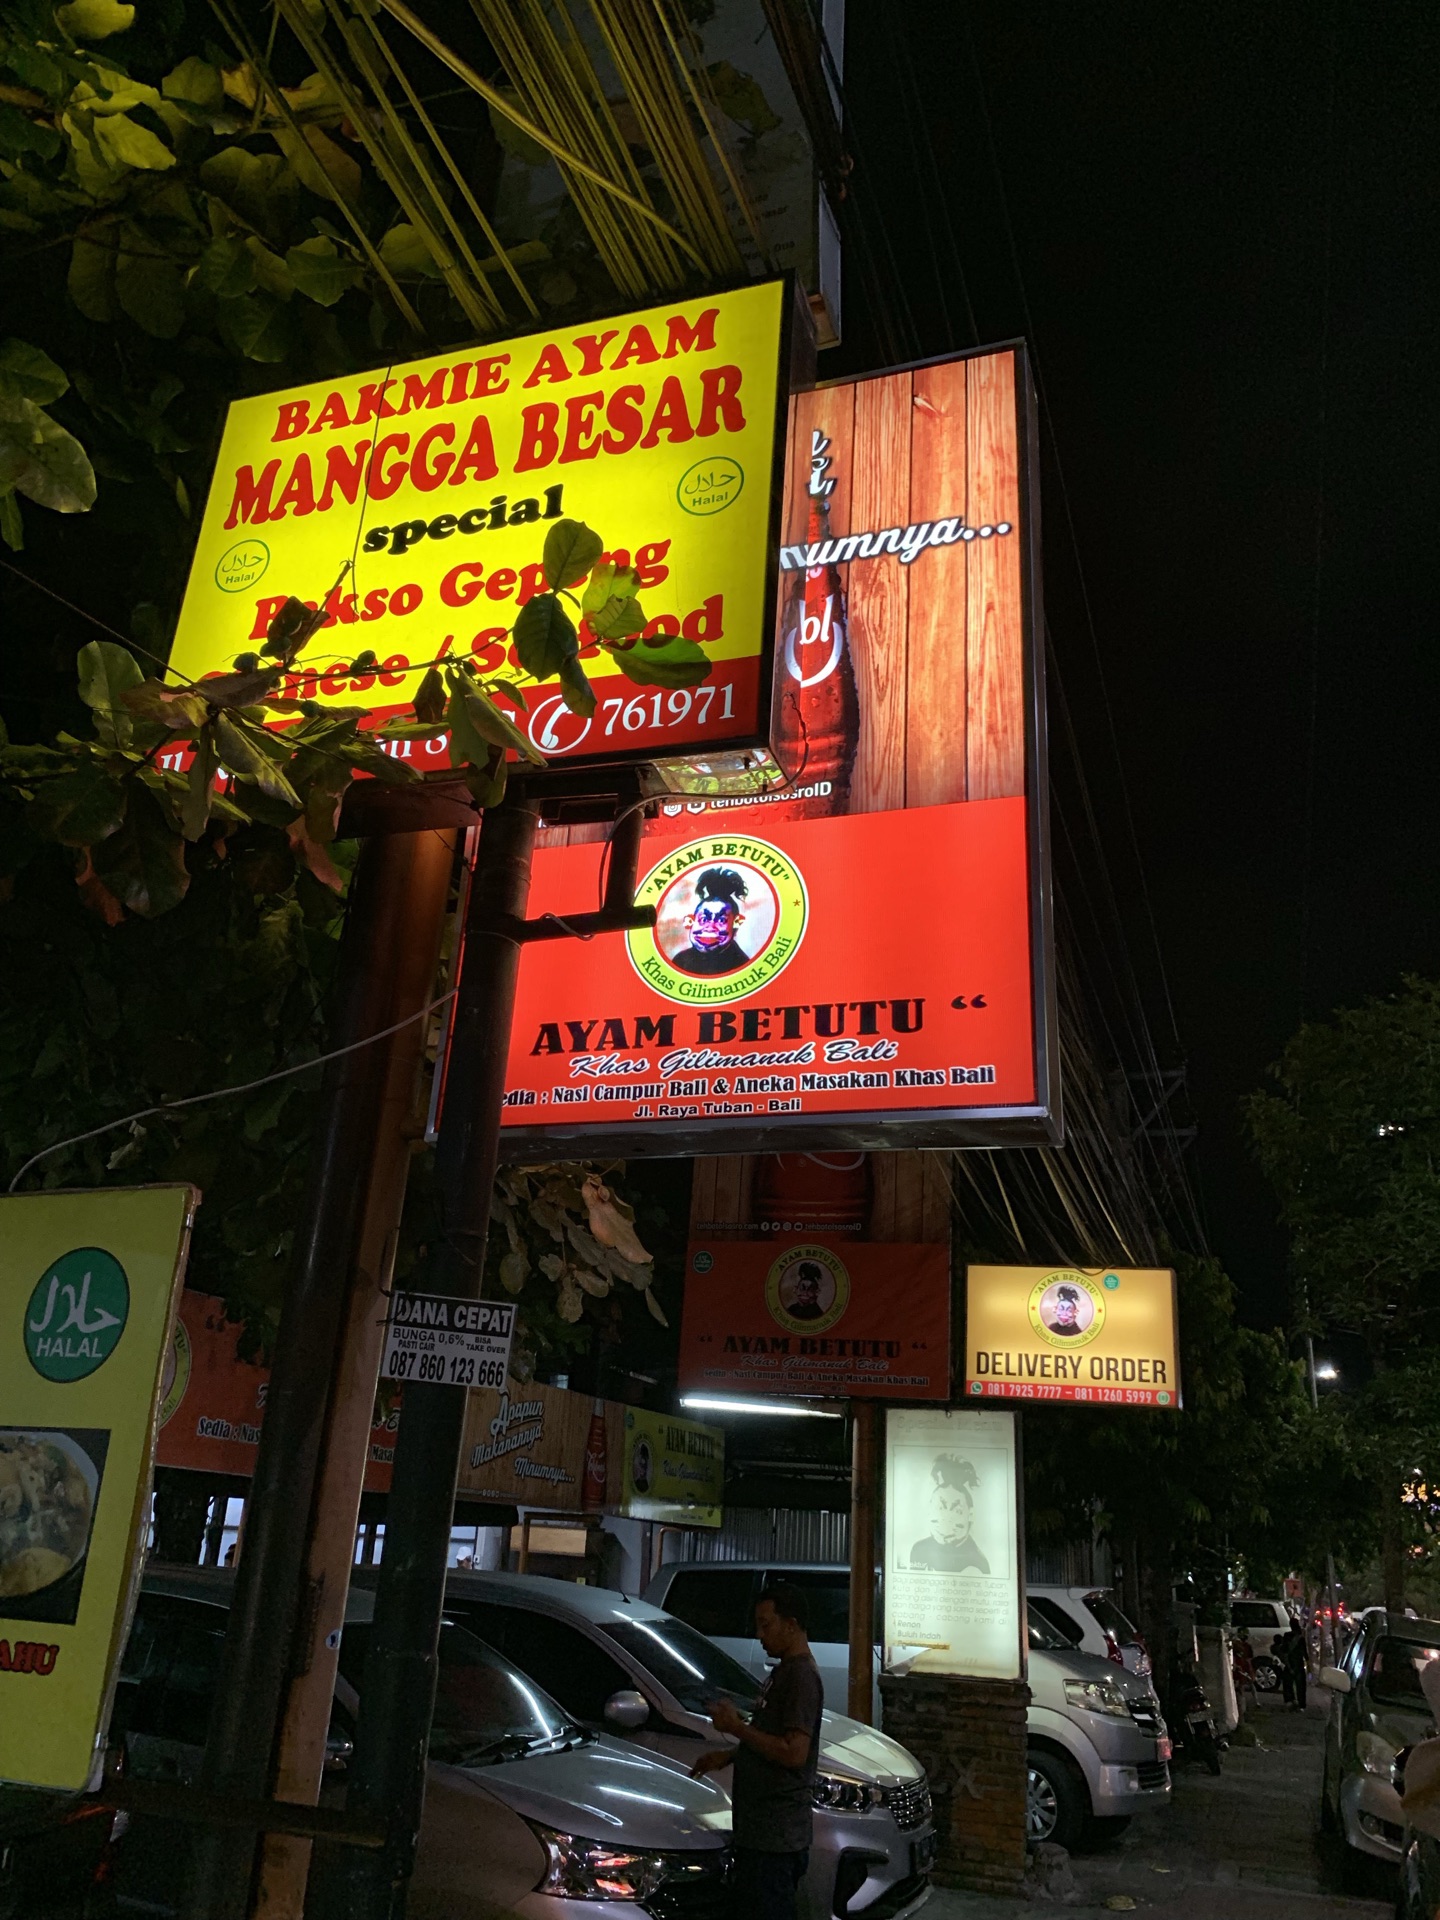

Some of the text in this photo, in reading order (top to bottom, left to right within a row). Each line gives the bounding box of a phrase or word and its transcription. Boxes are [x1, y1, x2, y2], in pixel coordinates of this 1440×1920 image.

[271, 308, 720, 442] BAKMIE AYAM
[225, 416, 499, 529] MANGGA
[514, 364, 746, 473] BESAR
[691, 491, 729, 507] Halal
[363, 484, 564, 555] special
[225, 571, 255, 585] Halal
[248, 583, 423, 640] Bkso
[602, 683, 735, 736] 761971
[641, 937, 792, 998] Khas Gilimanuk Bali
[530, 1013, 677, 1057] AYAM
[697, 998, 926, 1046] BETUTU
[570, 1039, 898, 1079] Khas Gilimanuk Bali
[553, 1086, 588, 1103] Nasi
[595, 1082, 664, 1103] Campur
[669, 1079, 706, 1097] Bali
[713, 1078, 728, 1094] &
[734, 1075, 795, 1094] Aneka
[800, 1071, 888, 1091] Masakan
[894, 1068, 945, 1087] Khas
[950, 1066, 995, 1085] Bali
[634, 1106, 653, 1118] Jl.
[658, 1105, 698, 1119] Raya
[703, 1102, 753, 1115] Tuban
[768, 1098, 801, 1112] Bali
[397, 1299, 512, 1333] DANA CEPAT
[35, 1337, 102, 1358] HALAL
[393, 1327, 435, 1343] BUNGA
[439, 1333, 464, 1346] 0,6%
[398, 1340, 506, 1354] PASTI CAIR TAKE OVER
[723, 1336, 791, 1353] AYAM
[800, 1338, 900, 1359] BETUTU
[389, 1350, 505, 1387] 087 860 123 666
[741, 1355, 889, 1371] Khas Gilimanuk Bali
[976, 1351, 1167, 1384] DELIVERY ORDER
[988, 1384, 1005, 1395] 081
[1009, 1384, 1034, 1397] 7925
[1037, 1386, 1062, 1398] 7777
[1074, 1388, 1092, 1400] 081
[1098, 1389, 1122, 1402] 1260
[1126, 1390, 1152, 1403] 5999
[197, 1416, 230, 1438] Sedia
[490, 1392, 544, 1436] Apapun
[897, 1619, 921, 1629] Renon
[920, 1631, 941, 1640] Indah
